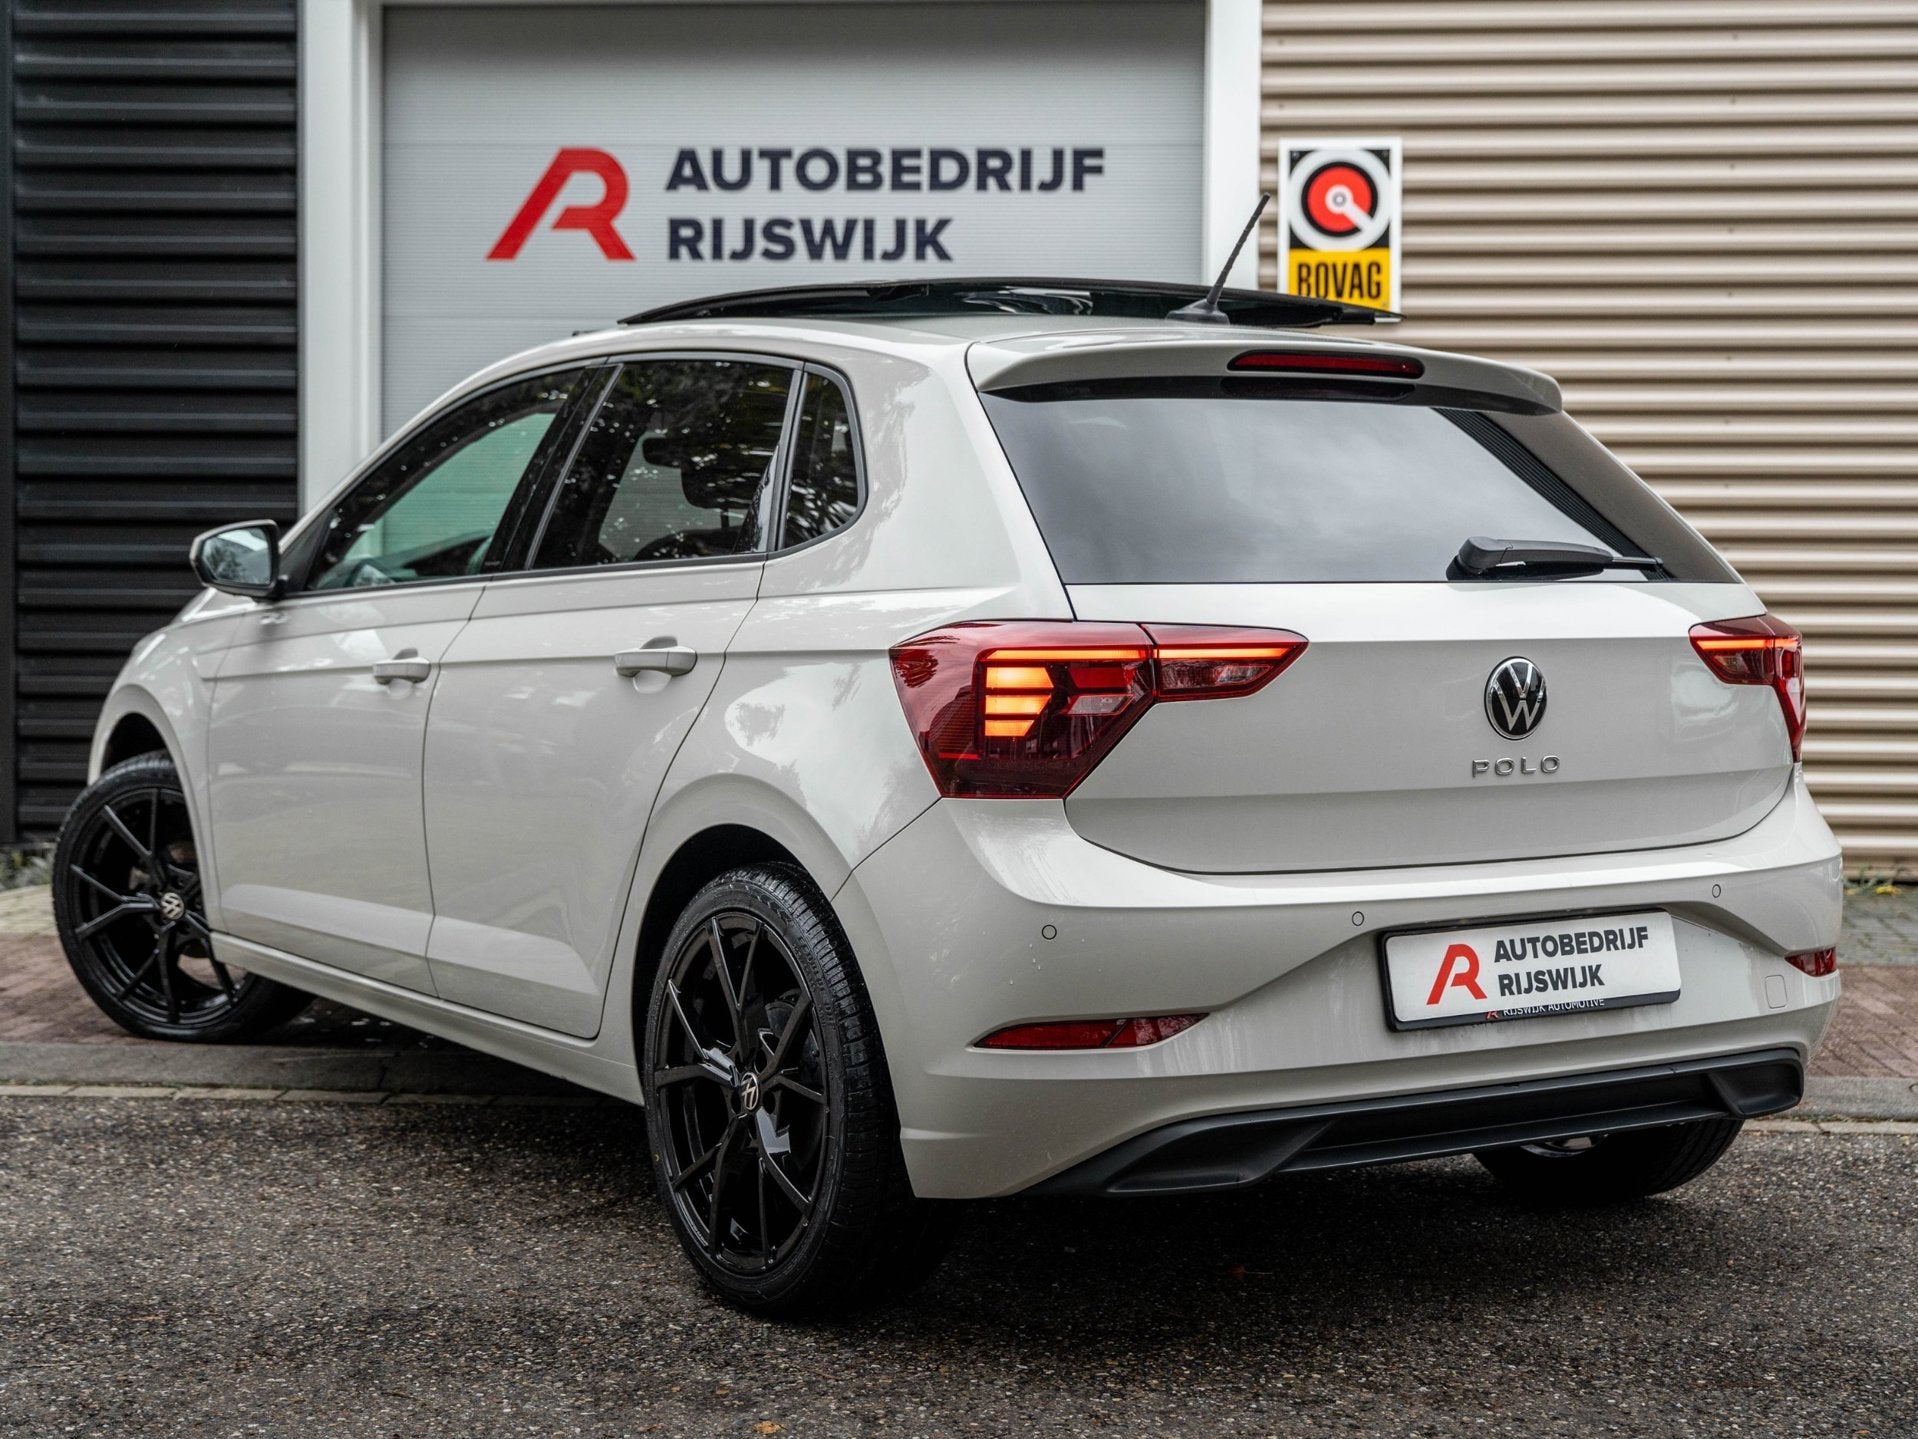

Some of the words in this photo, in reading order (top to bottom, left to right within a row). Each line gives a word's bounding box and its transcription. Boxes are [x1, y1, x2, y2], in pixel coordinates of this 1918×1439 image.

[665, 147, 1105, 191] AUTOBEDRIJF
[668, 218, 953, 262] RIJSWIJK
[1297, 261, 1382, 300] BOVAG
[1472, 755, 1561, 778] POLO
[1494, 926, 1649, 963] AUTOBEDRIJF
[1498, 964, 1605, 997] RIJSWIJK
[1503, 1004, 1547, 1017] RIJSWIJK
[1548, 998, 1606, 1012] AUTOMOTIVE
